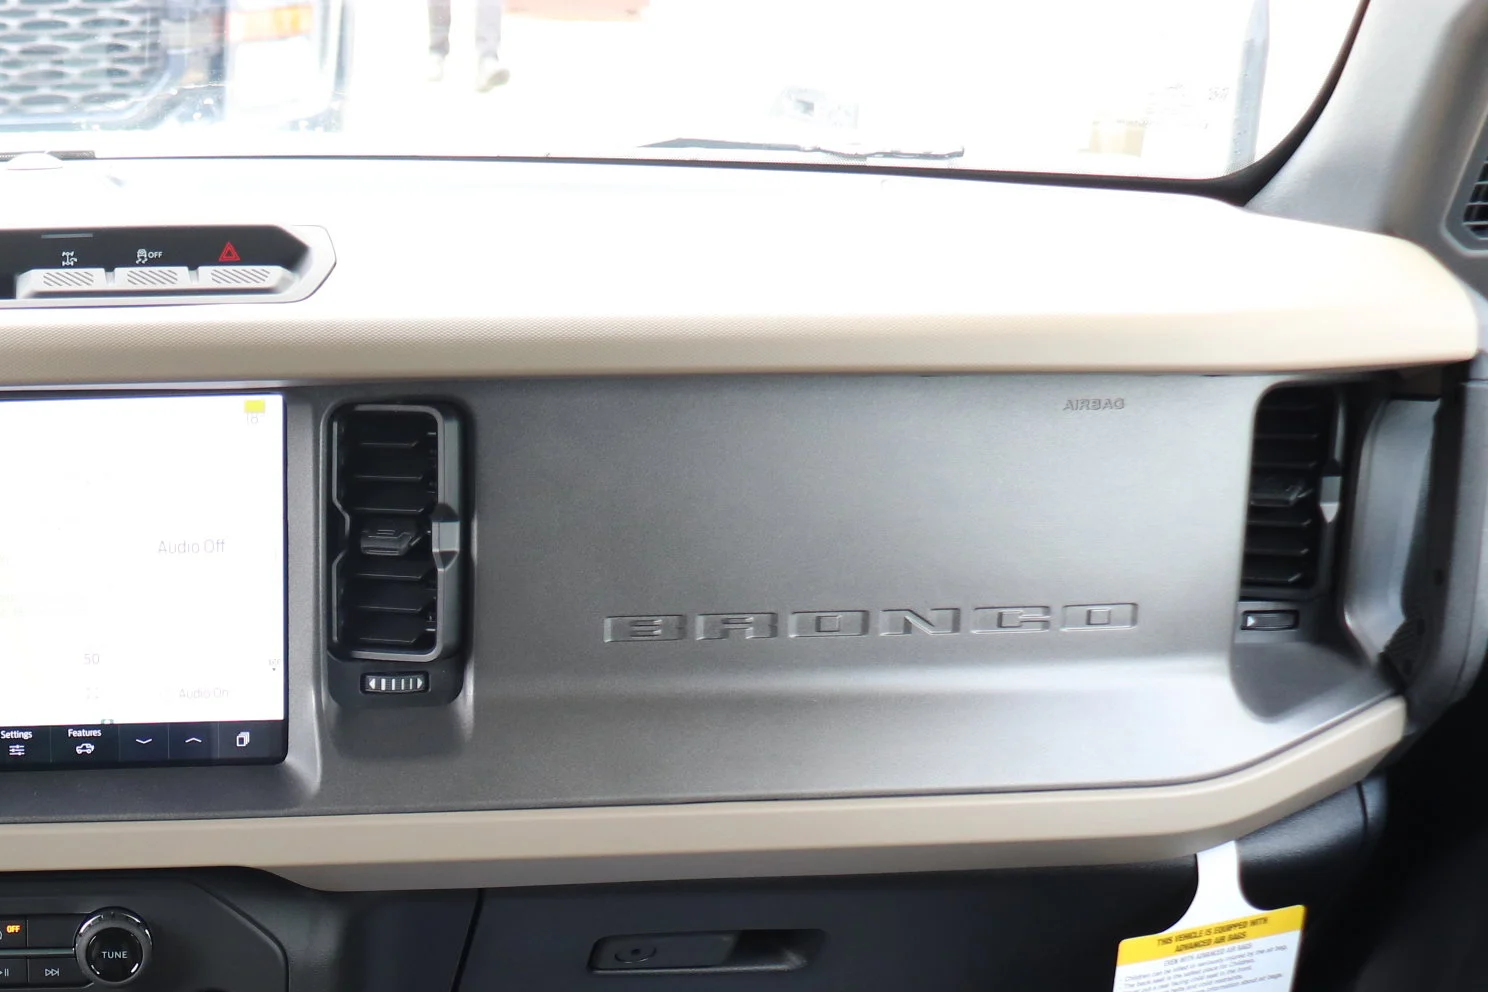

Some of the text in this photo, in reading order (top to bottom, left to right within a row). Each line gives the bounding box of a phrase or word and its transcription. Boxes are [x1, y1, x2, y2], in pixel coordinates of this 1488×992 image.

[147, 251, 163, 259] OFF
[1062, 397, 1126, 412] AIRBAG
[158, 537, 225, 554] Audio Off
[603, 602, 1139, 644] BRONCO
[83, 653, 100, 665] 50
[178, 687, 229, 699] Audio On
[0, 729, 33, 741] Settings
[67, 727, 102, 738] Features
[6, 924, 21, 934] OFF
[101, 950, 128, 959] TUNE
